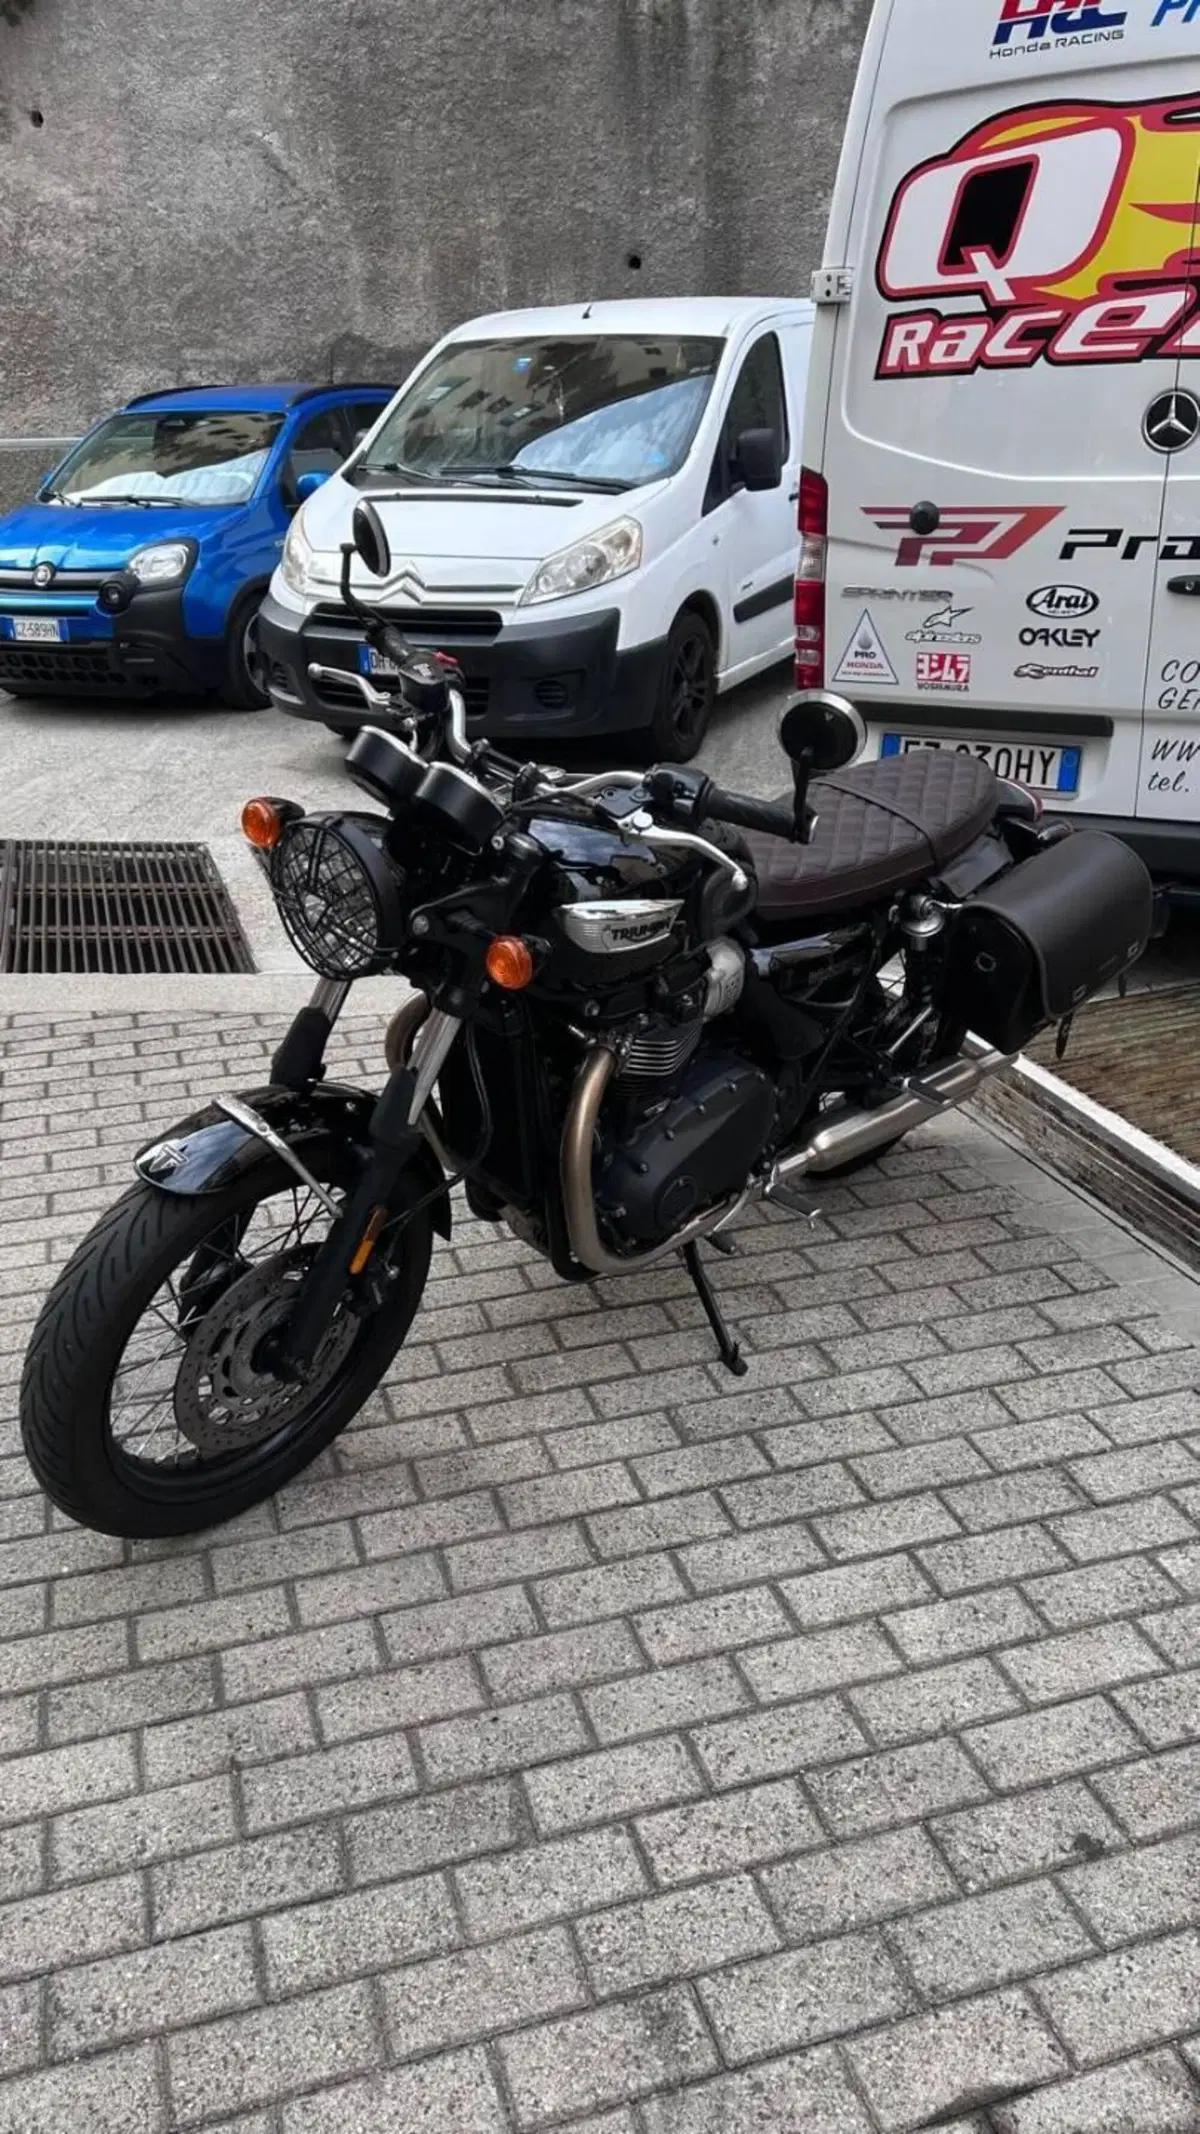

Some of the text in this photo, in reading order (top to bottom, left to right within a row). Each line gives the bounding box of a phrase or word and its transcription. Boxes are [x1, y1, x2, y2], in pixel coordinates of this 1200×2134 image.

[989, 29, 1124, 59] Honda RACING
[1032, 586, 1091, 608] Arai
[1019, 627, 1100, 647] OAKLEY
[854, 651, 877, 659] PRO
[1148, 771, 1189, 792] tel.
[611, 920, 672, 941] TRIUMPH
